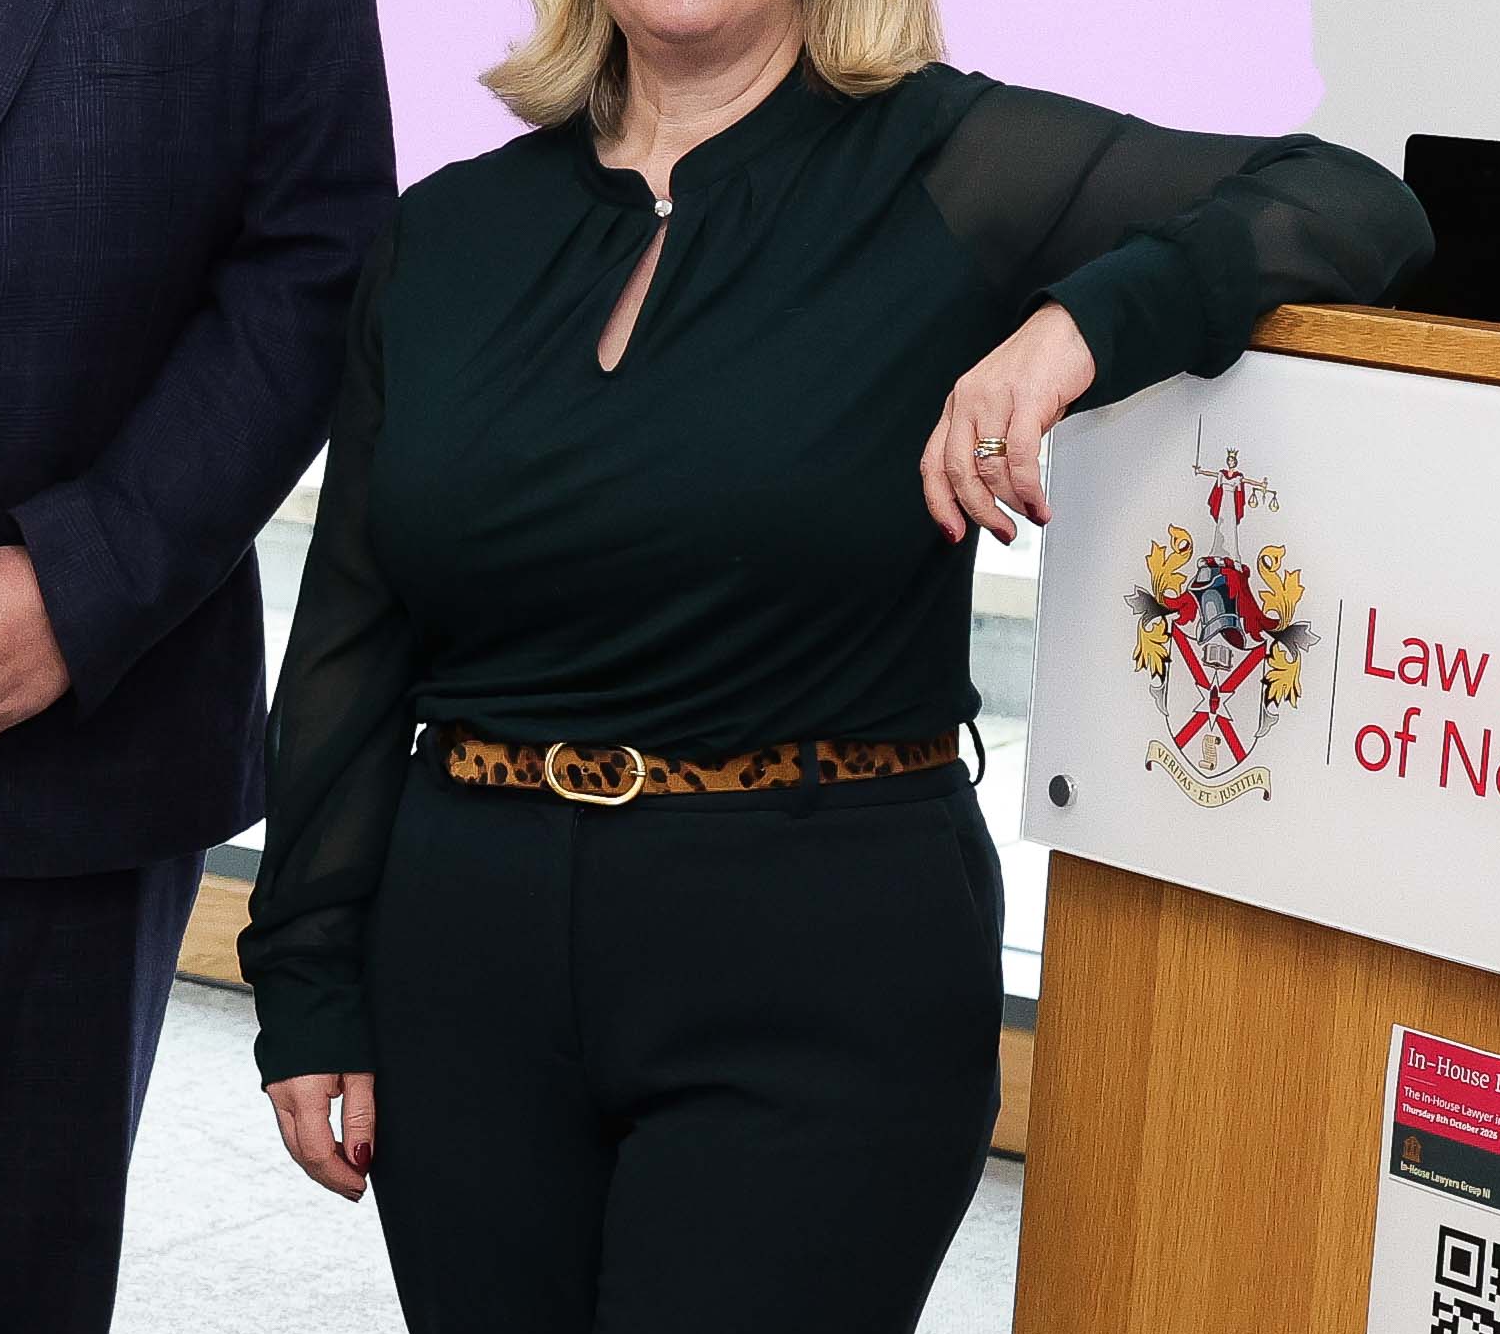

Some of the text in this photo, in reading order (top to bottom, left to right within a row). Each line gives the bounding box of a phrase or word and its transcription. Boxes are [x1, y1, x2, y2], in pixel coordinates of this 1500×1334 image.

[1364, 607, 1490, 698] Law
[1354, 706, 1422, 778] of
[1157, 748, 1264, 803] VERITAS ET JUSTITIA
[1407, 1047, 1490, 1088] In-House
[1402, 1103, 1435, 1123] Thursday
[1449, 1117, 1479, 1135] October
[1404, 1086, 1420, 1101] The
[1422, 1090, 1460, 1113] In-House
[1461, 1104, 1494, 1123] Lawyer
[1431, 1171, 1460, 1190] Lawyers
